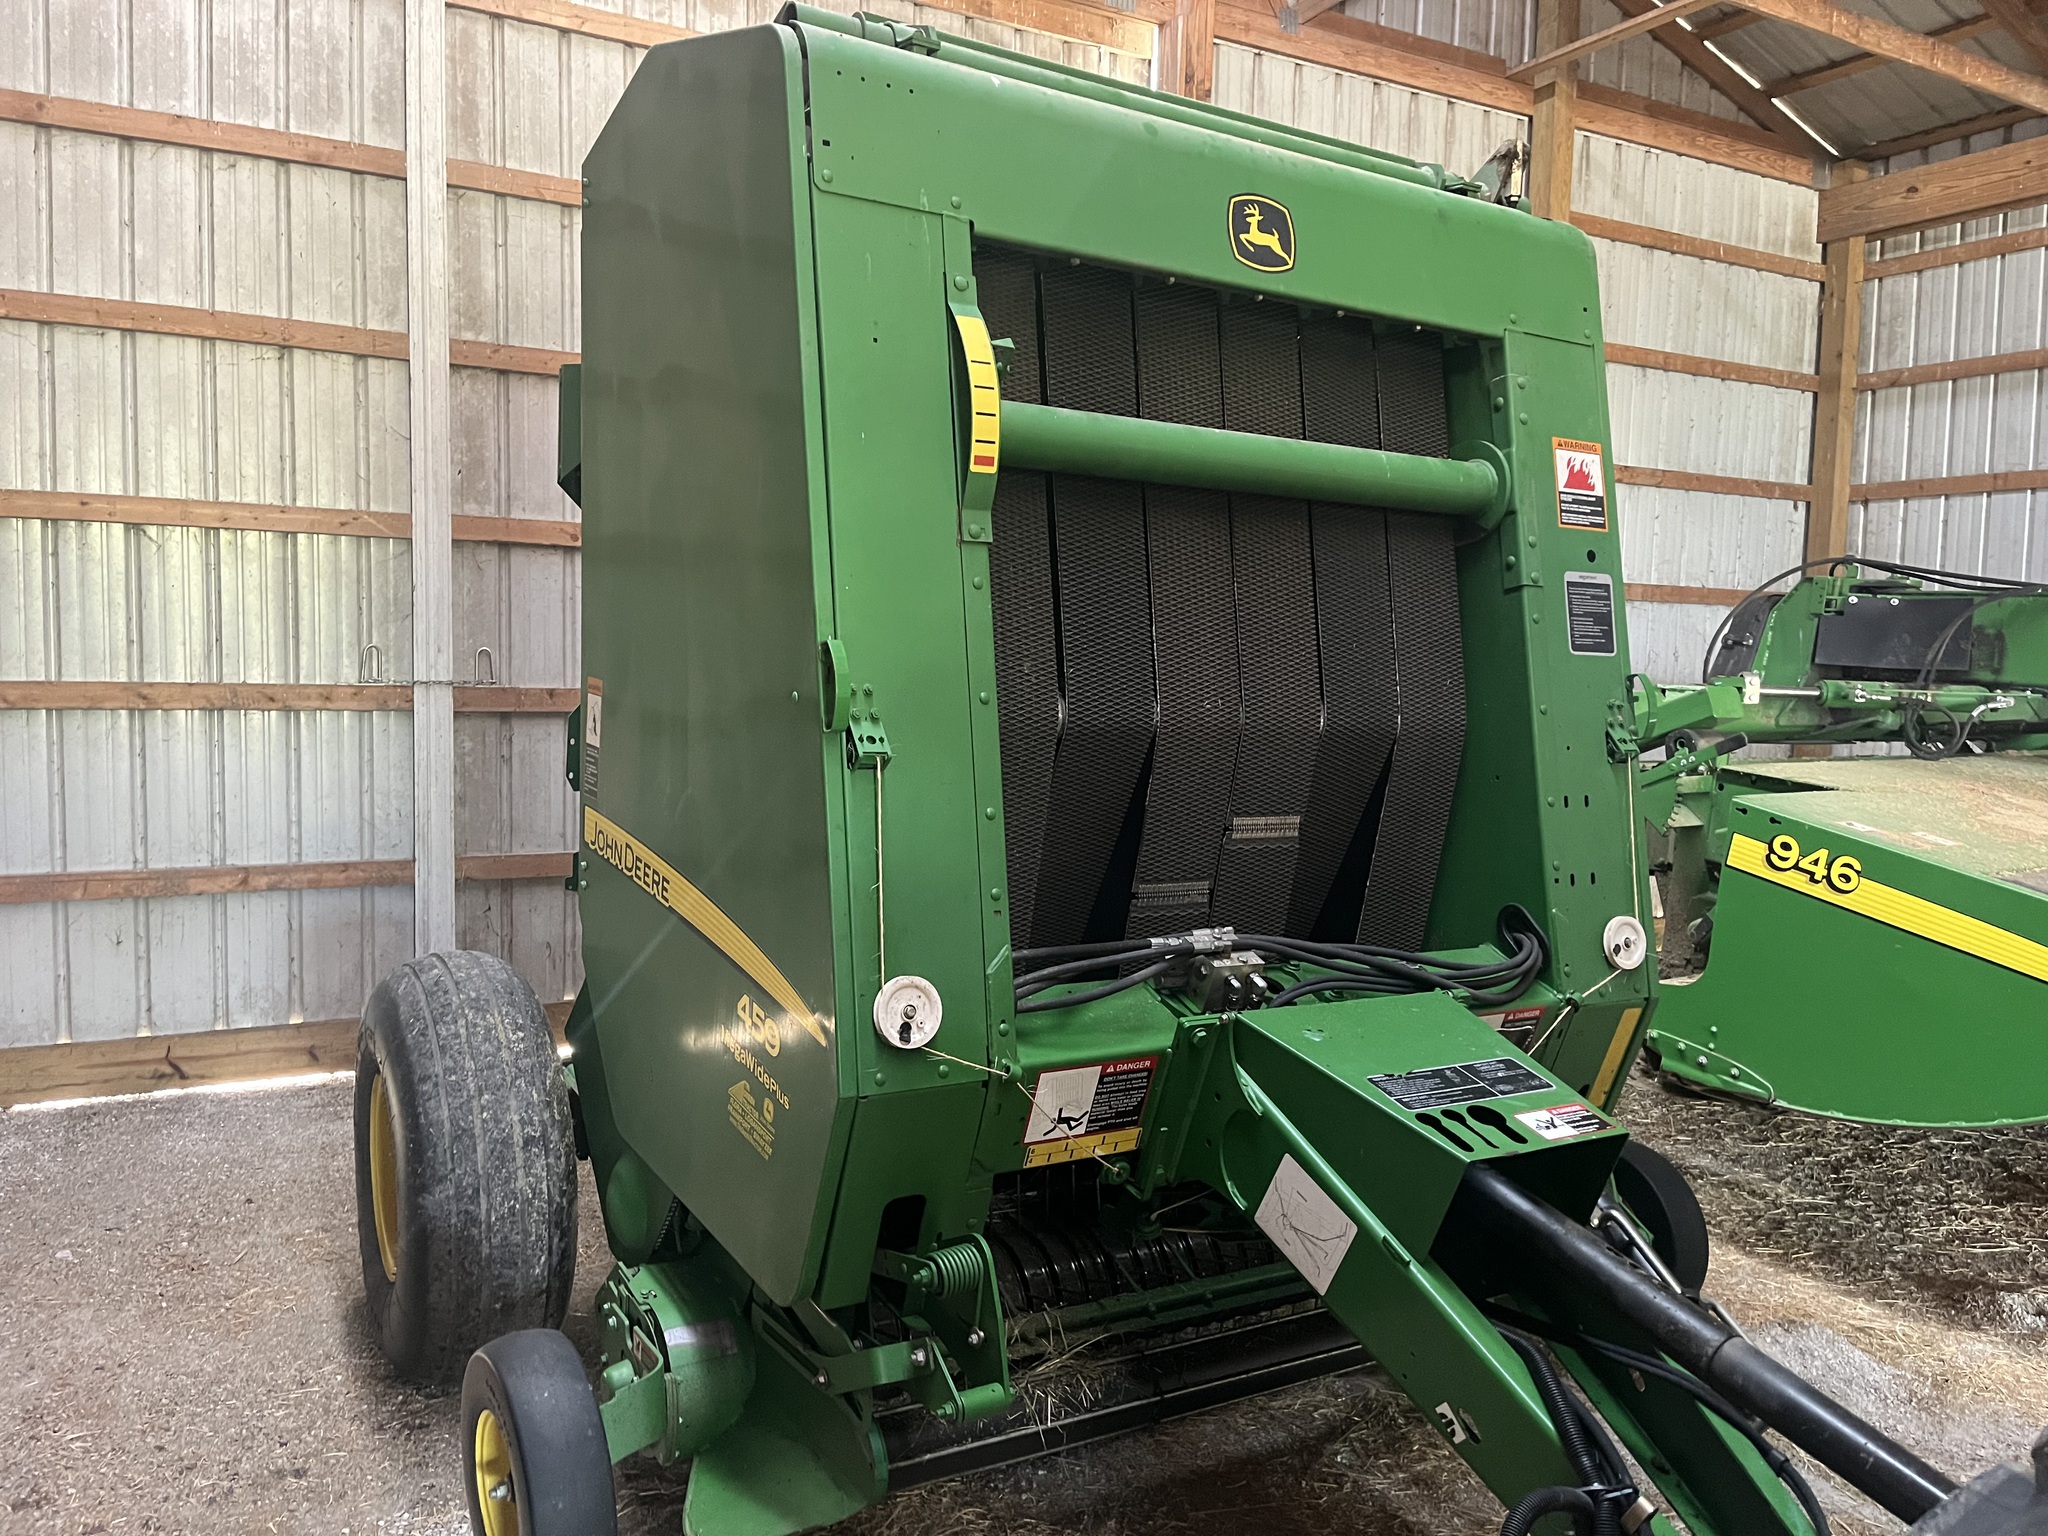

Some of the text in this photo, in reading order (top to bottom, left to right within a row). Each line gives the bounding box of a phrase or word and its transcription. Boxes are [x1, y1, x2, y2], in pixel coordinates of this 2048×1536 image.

[1563, 441, 1598, 453] WARNING
[590, 821, 670, 904] JOHN DEERE
[1765, 834, 1862, 894] 946
[737, 993, 781, 1057] 459
[1514, 1009, 1541, 1020] DANGER
[1116, 1060, 1151, 1072] DANGER
